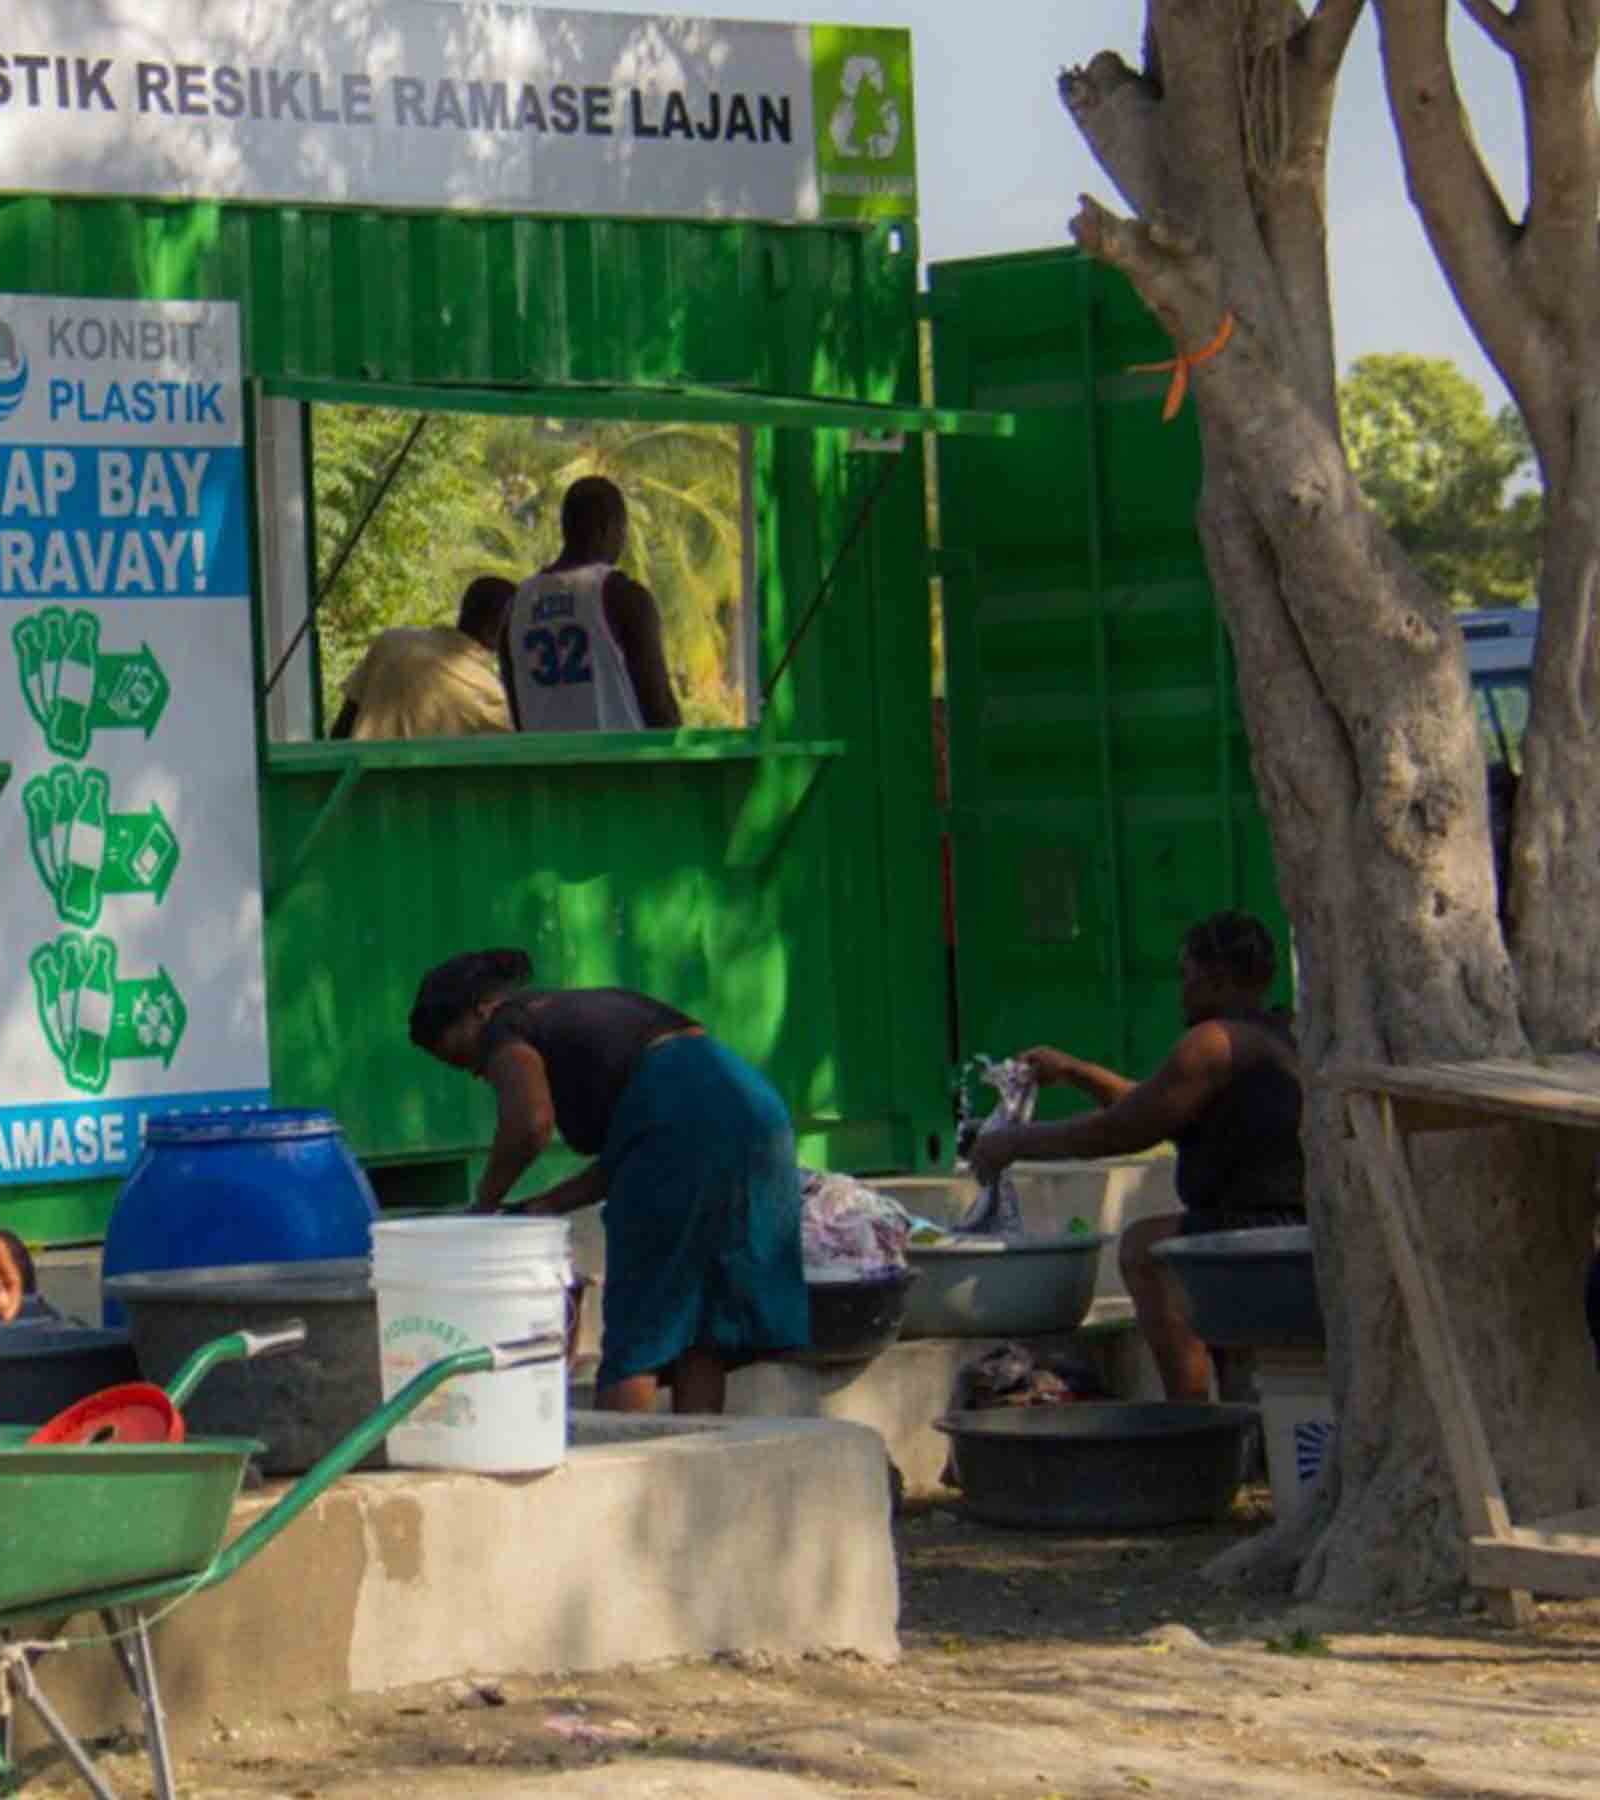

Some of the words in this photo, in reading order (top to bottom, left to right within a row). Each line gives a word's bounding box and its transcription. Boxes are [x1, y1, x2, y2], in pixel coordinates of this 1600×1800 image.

[136, 61, 376, 125] RESIKLE
[396, 74, 613, 136] RAMASE
[631, 86, 793, 143] LAJAN
[47, 318, 206, 361] KONBIT
[48, 379, 225, 424] PLASTIK
[99, 450, 209, 518] BAY
[523, 626, 592, 686] 32
